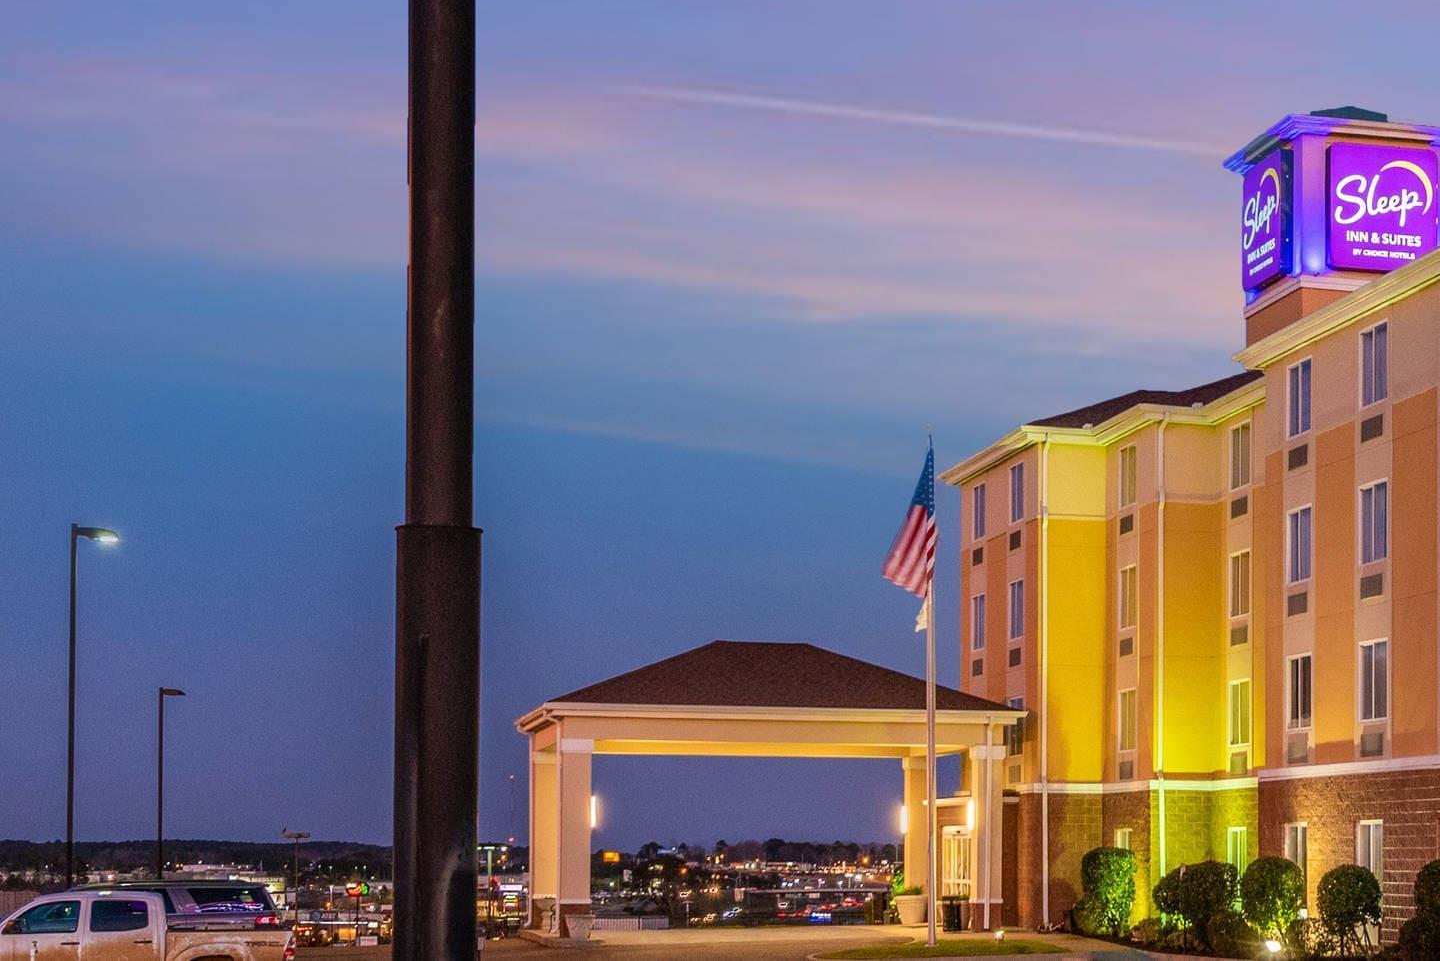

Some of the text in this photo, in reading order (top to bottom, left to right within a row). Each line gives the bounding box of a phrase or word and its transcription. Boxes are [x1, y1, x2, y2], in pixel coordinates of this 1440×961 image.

[1243, 191, 1276, 250] Sleep
[1334, 174, 1424, 228] Sleep
[1346, 230, 1422, 247] INN & SUITES
